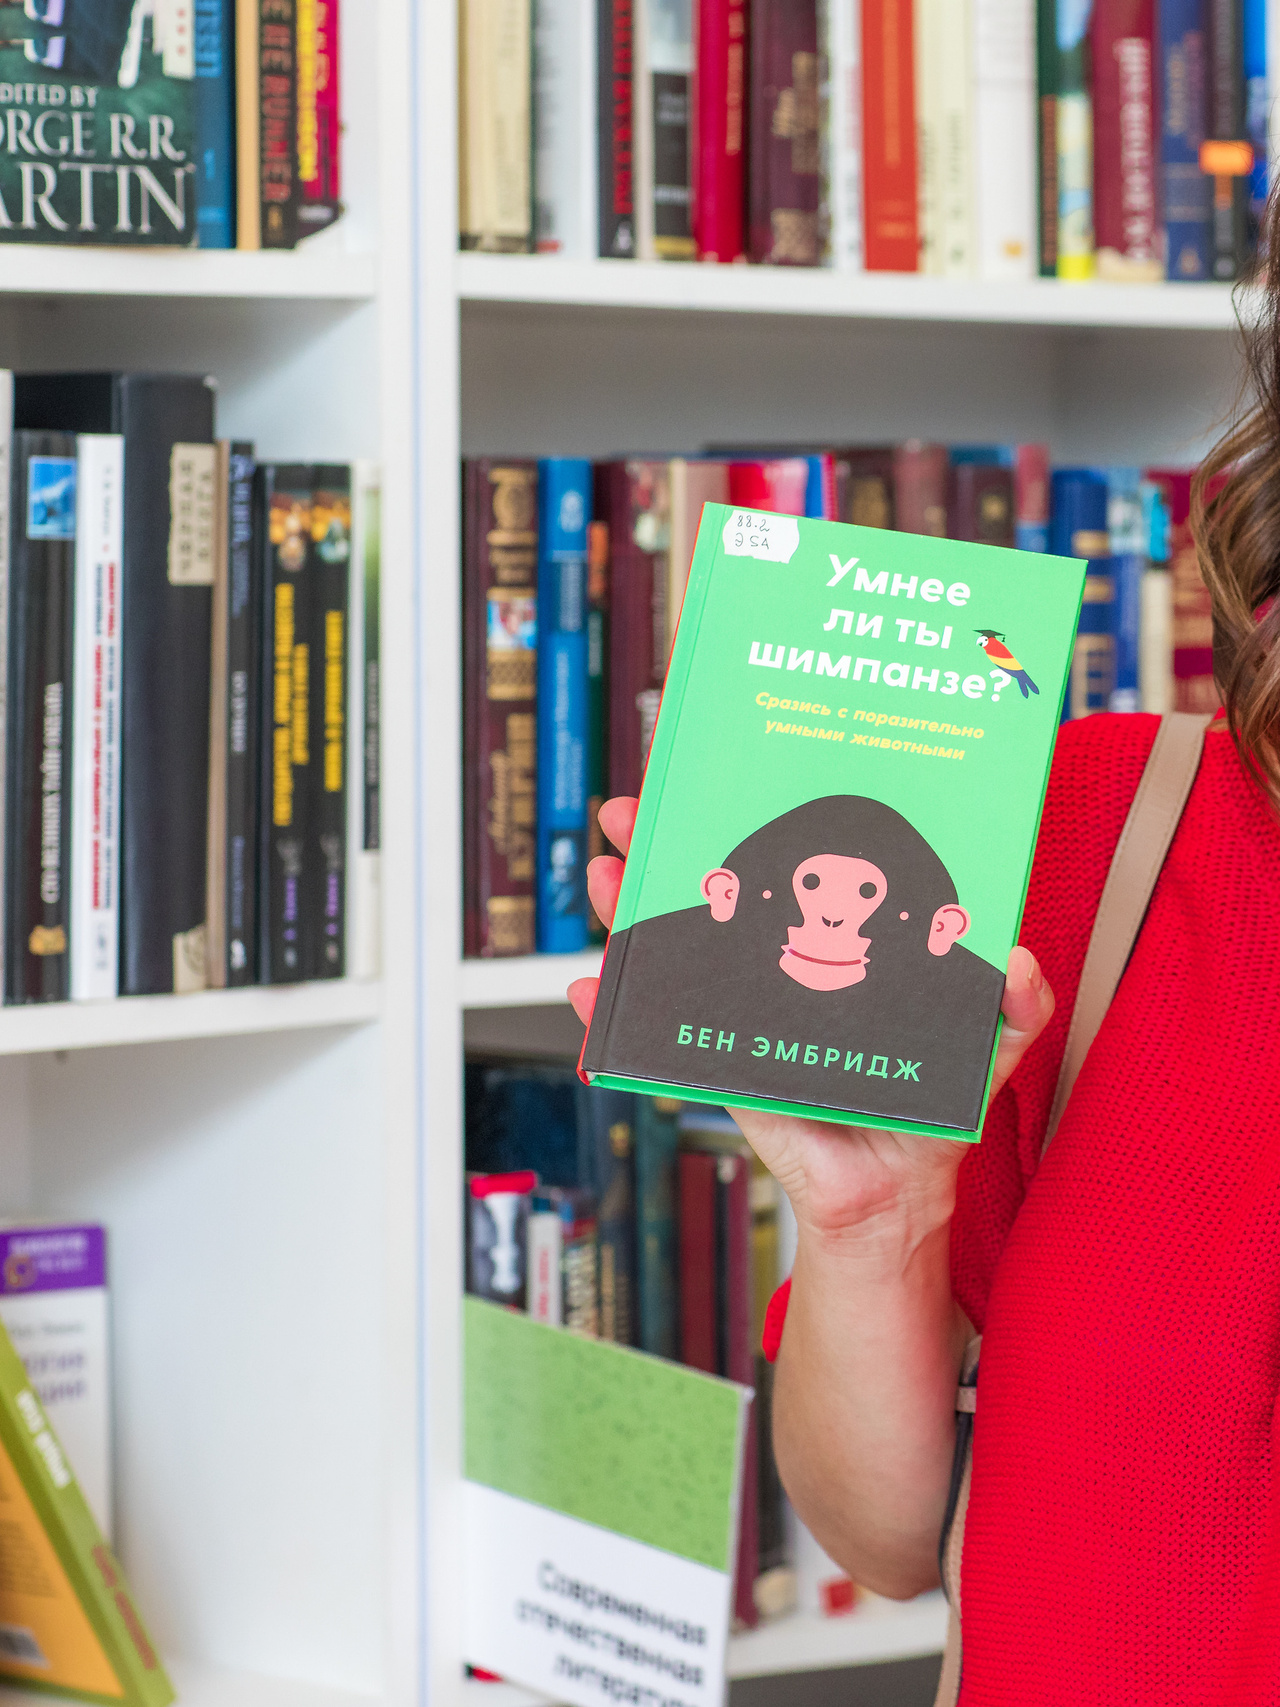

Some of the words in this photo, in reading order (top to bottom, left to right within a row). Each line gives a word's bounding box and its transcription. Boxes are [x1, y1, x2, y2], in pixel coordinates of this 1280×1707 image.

[70, 85, 99, 108] BY
[0, 109, 95, 157] RGE
[737, 514, 770, 532] 88.2
[826, 553, 971, 607] Умнее
[823, 608, 884, 639] ли
[895, 618, 953, 649] ты
[748, 641, 1012, 702] шимпанзе?
[755, 692, 832, 717] Сразись
[838, 707, 849, 719] с
[853, 710, 985, 739] поразительно
[765, 720, 845, 742] умными
[850, 733, 966, 760] животными
[677, 1024, 736, 1052] БЕН
[751, 1036, 923, 1082] ЭМБРИДЖ
[537, 1561, 706, 1646] Современная
[554, 1652, 698, 1707] литерат
